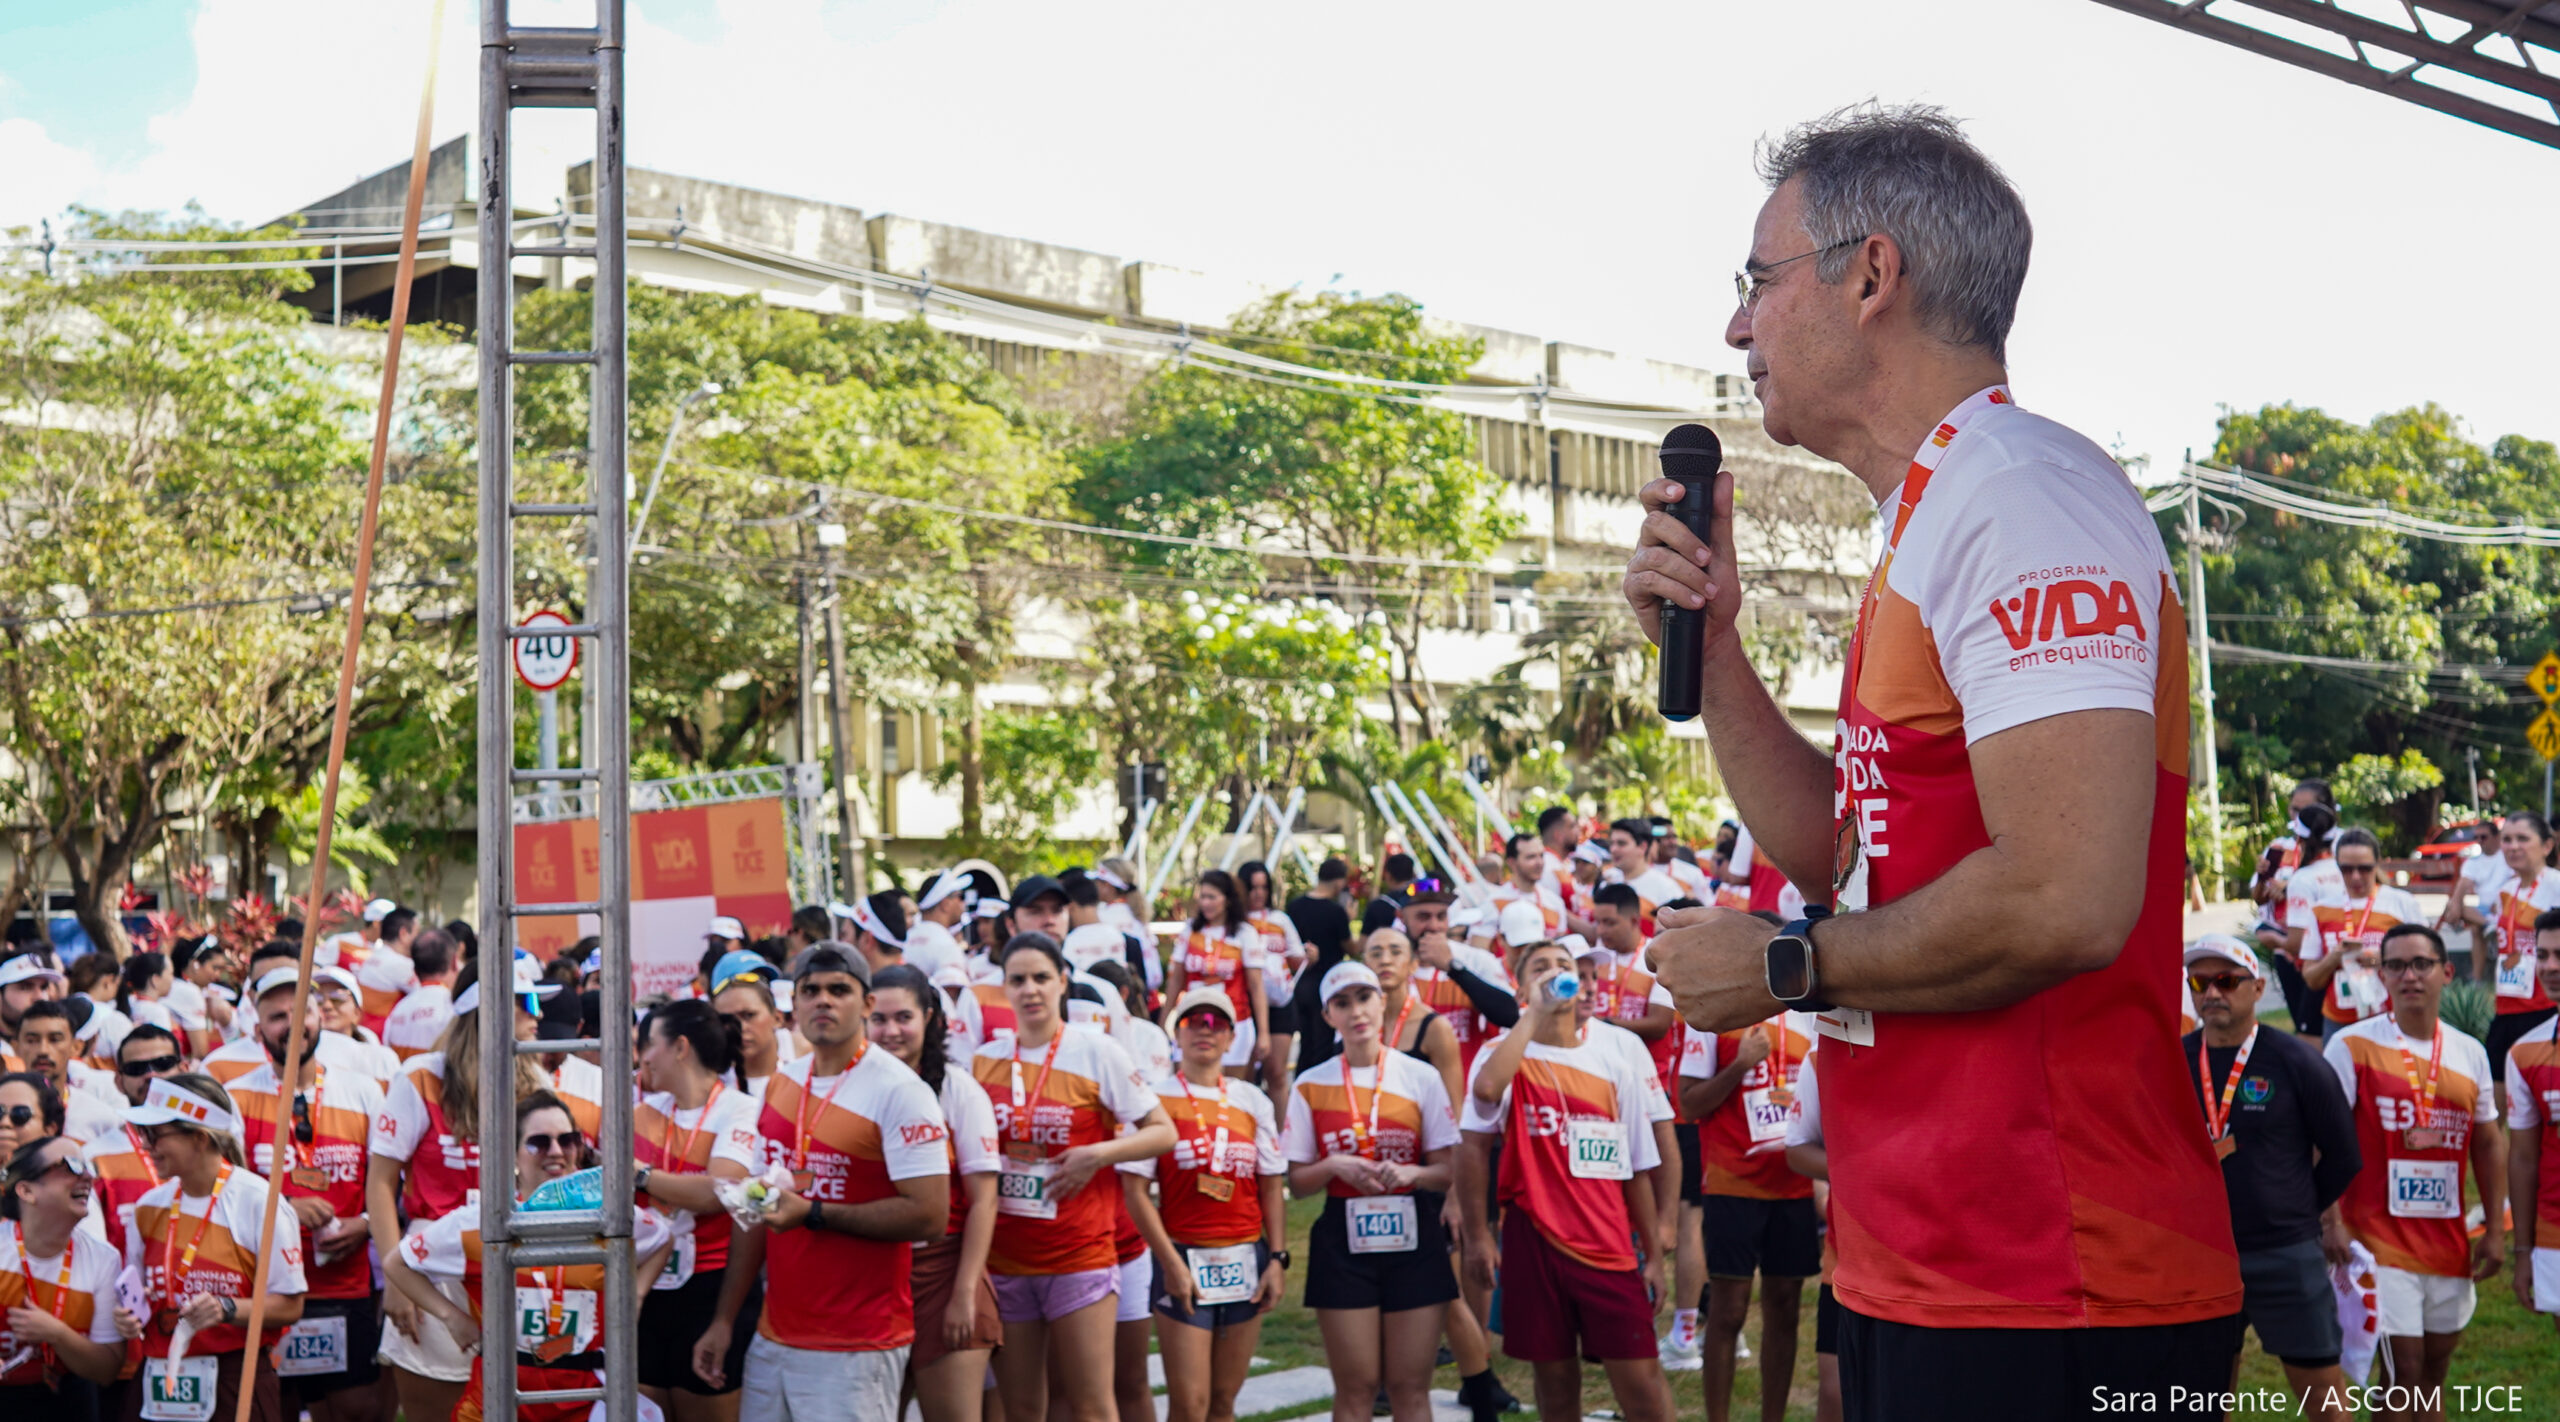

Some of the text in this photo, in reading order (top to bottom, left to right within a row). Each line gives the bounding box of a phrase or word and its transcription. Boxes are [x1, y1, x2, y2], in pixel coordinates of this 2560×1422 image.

[2018, 565, 2109, 585] PROGRAMA
[1989, 579, 2147, 651] VIDA
[523, 634, 567, 660] 40
[2009, 652, 2039, 672] em
[1580, 1140, 1618, 1160] 1072
[803, 1177, 846, 1199] JCE
[1002, 1175, 1038, 1198] 880
[2402, 1180, 2445, 1199] 1230
[1357, 1215, 1400, 1236] 1401
[1201, 1265, 1243, 1288] 1899
[530, 1310, 573, 1336] 57
[289, 1335, 332, 1359] 1842
